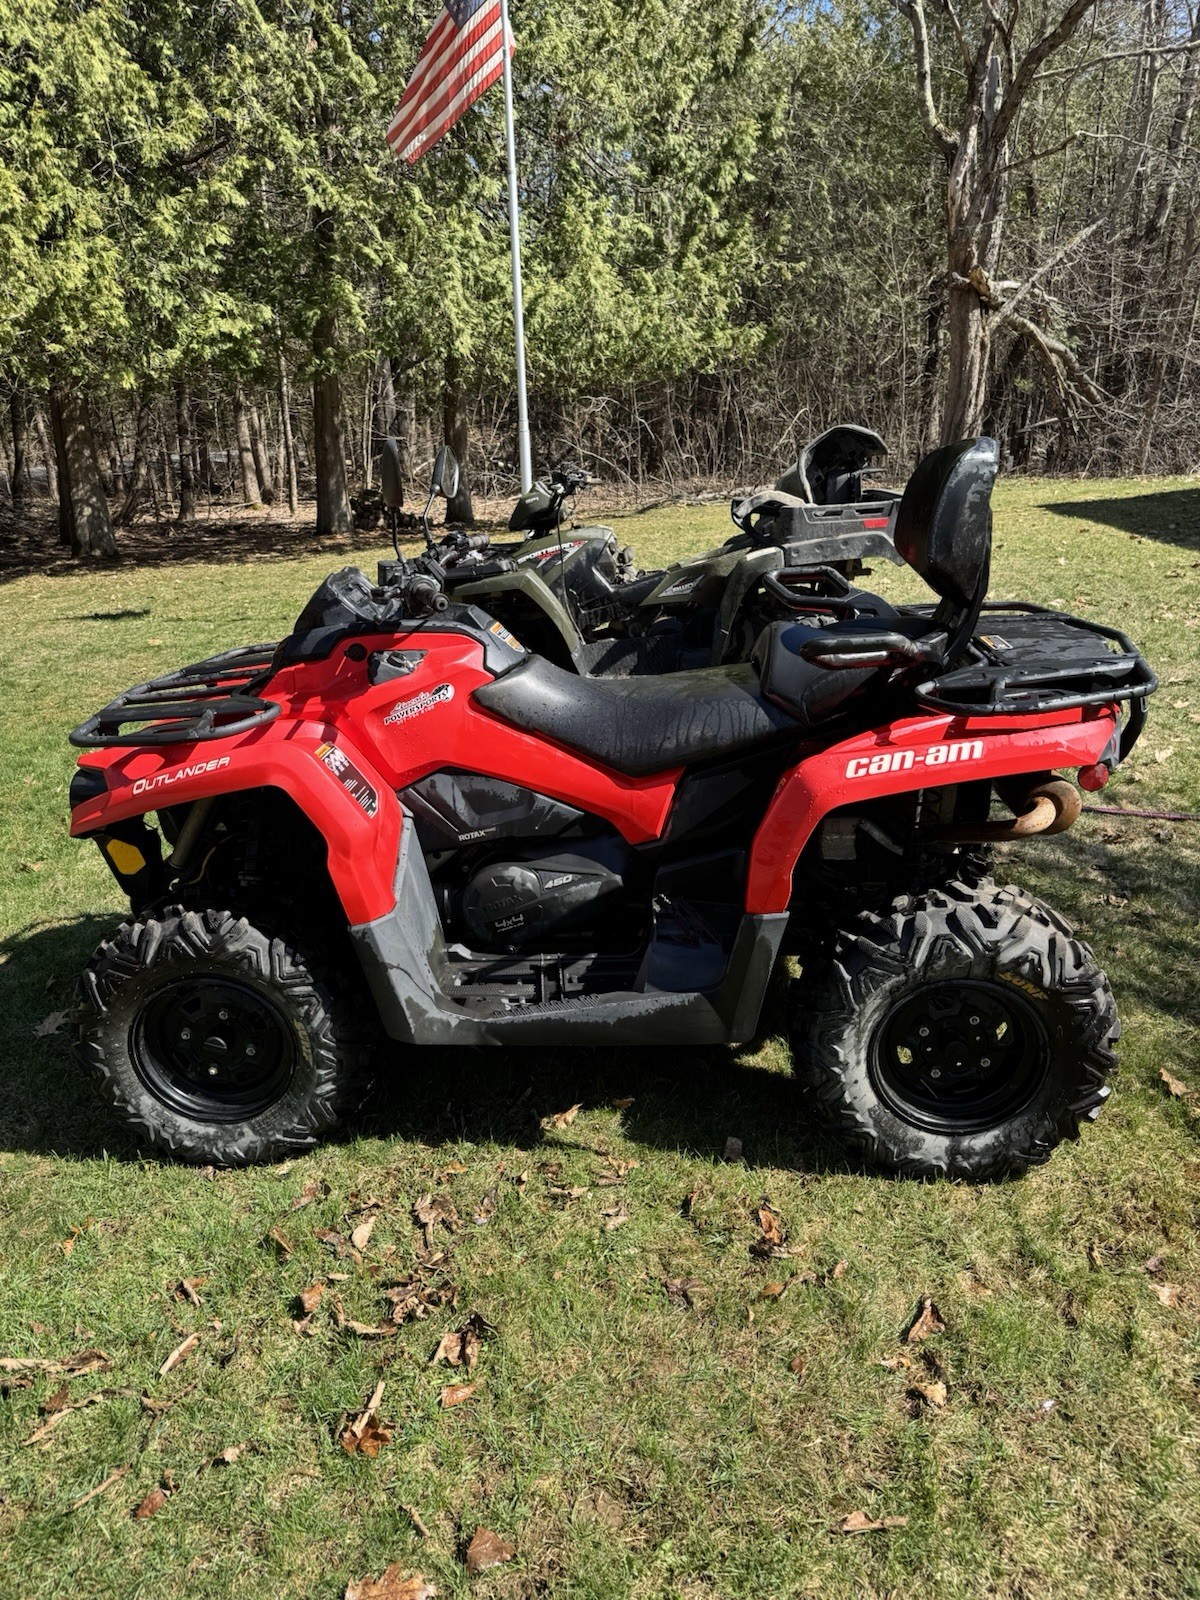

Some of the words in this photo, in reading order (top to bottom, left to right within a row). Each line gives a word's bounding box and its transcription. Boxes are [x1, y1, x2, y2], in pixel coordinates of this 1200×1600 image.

[384, 691, 447, 725] POWERSPORTS
[845, 740, 984, 779] can-am
[458, 829, 486, 841] ROTAX
[544, 873, 573, 888] 450
